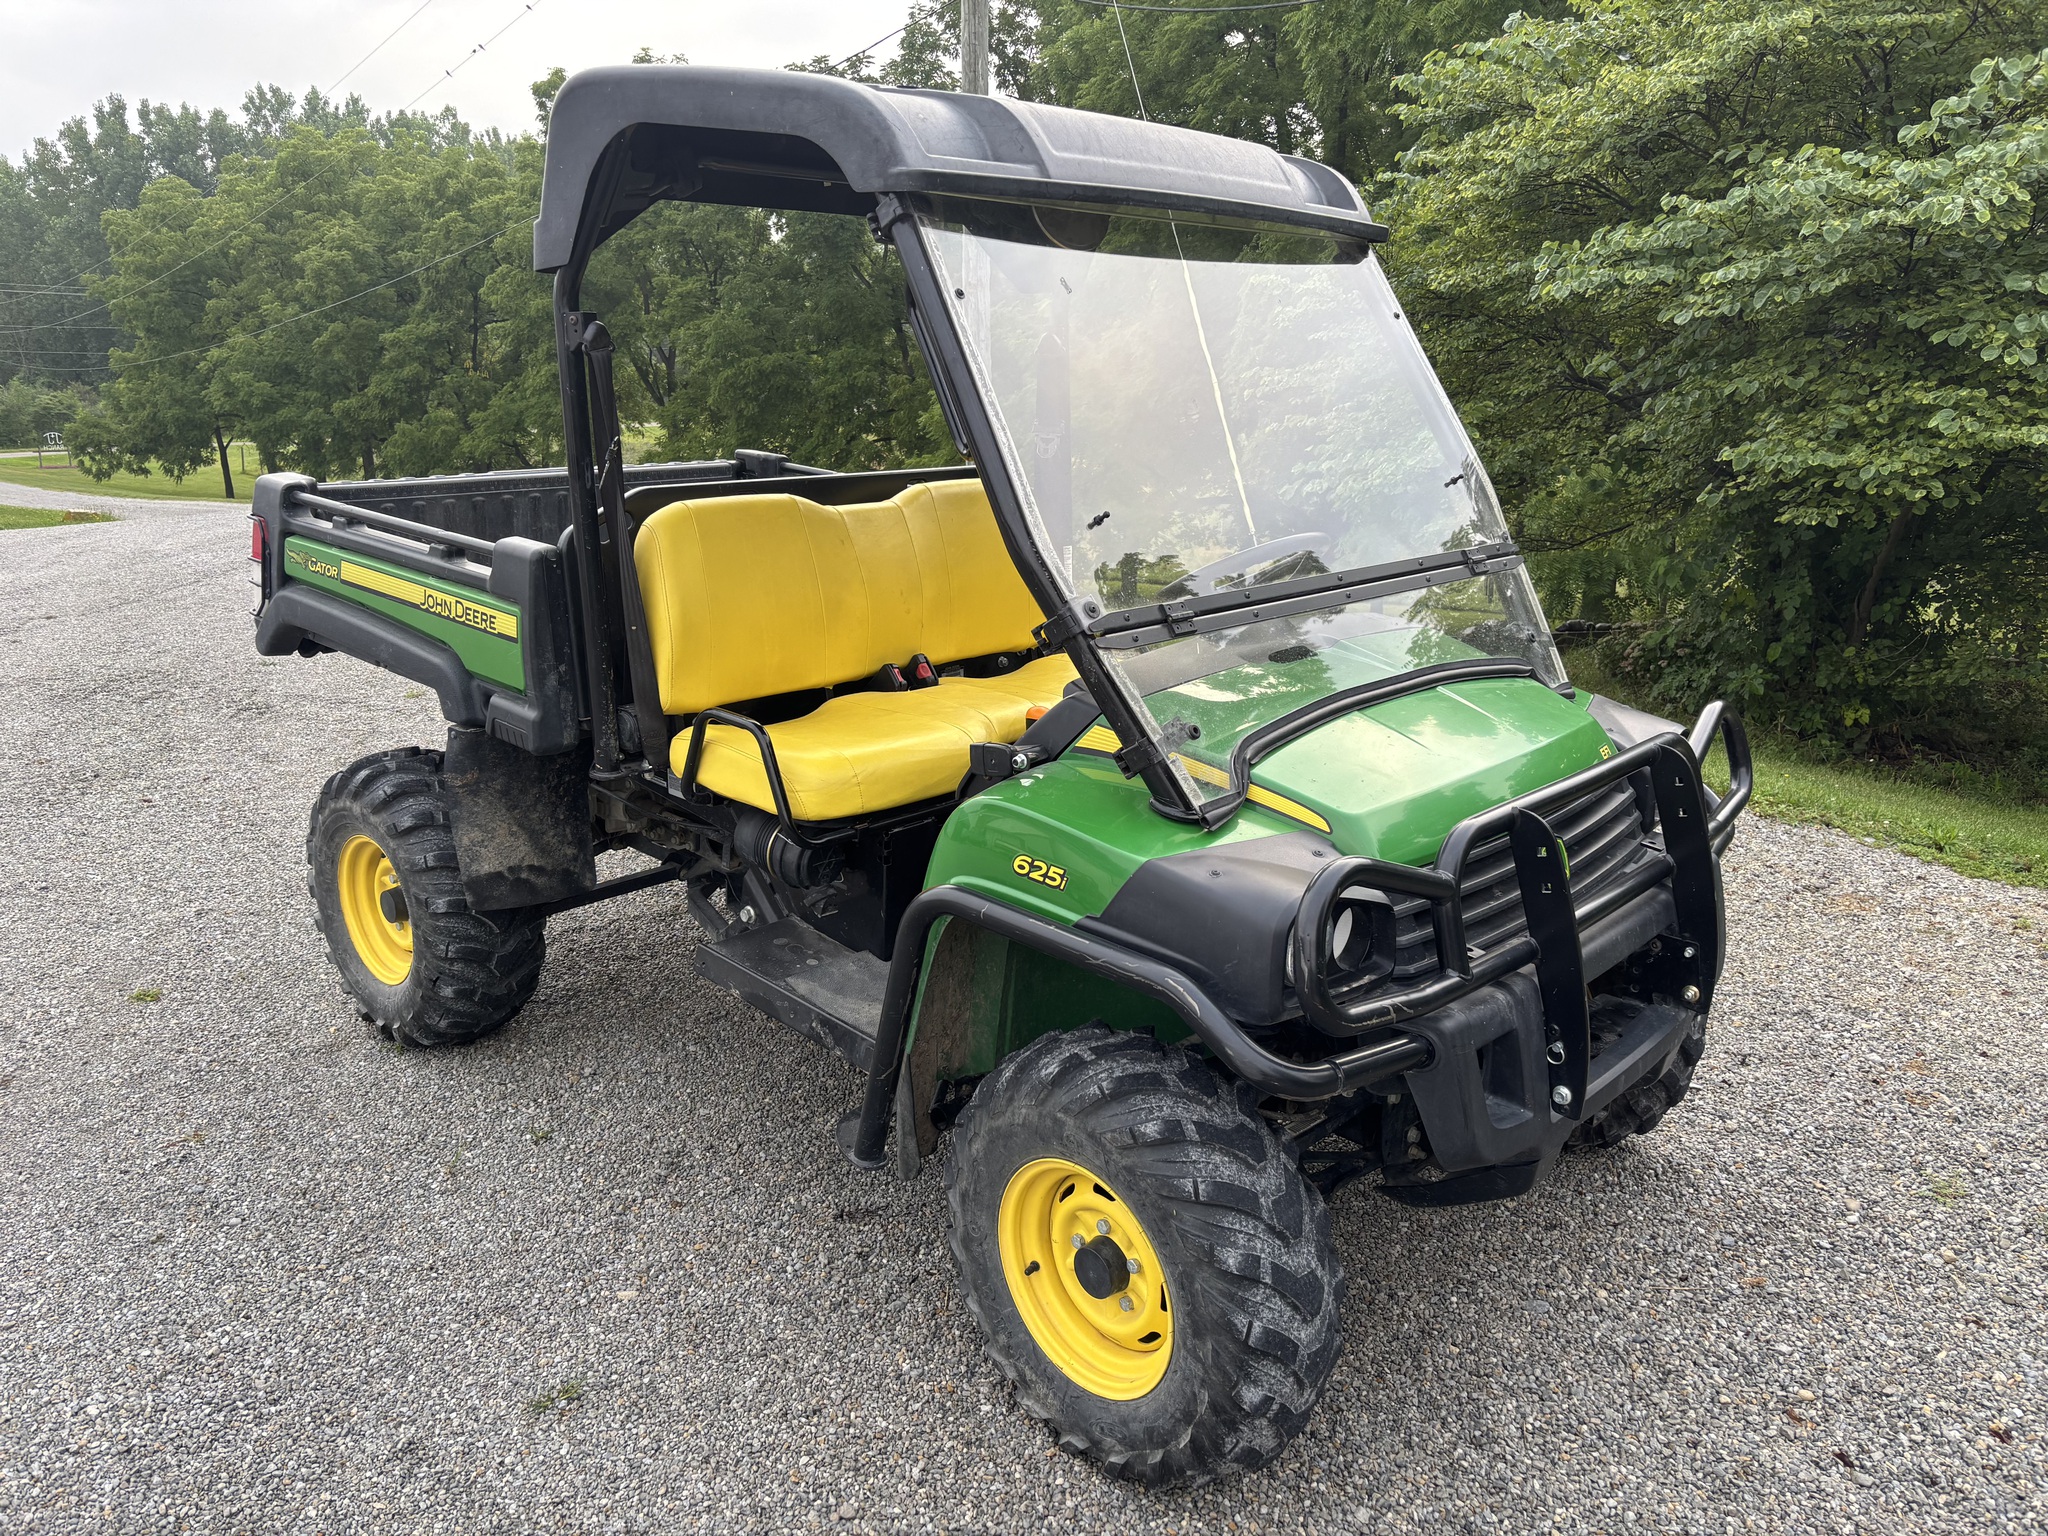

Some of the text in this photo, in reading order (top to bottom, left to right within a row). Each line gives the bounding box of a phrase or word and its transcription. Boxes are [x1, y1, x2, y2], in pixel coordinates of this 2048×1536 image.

[308, 557, 339, 579] GATOR
[420, 589, 498, 633] JOHN DEERE
[1012, 854, 1068, 891] 625i
